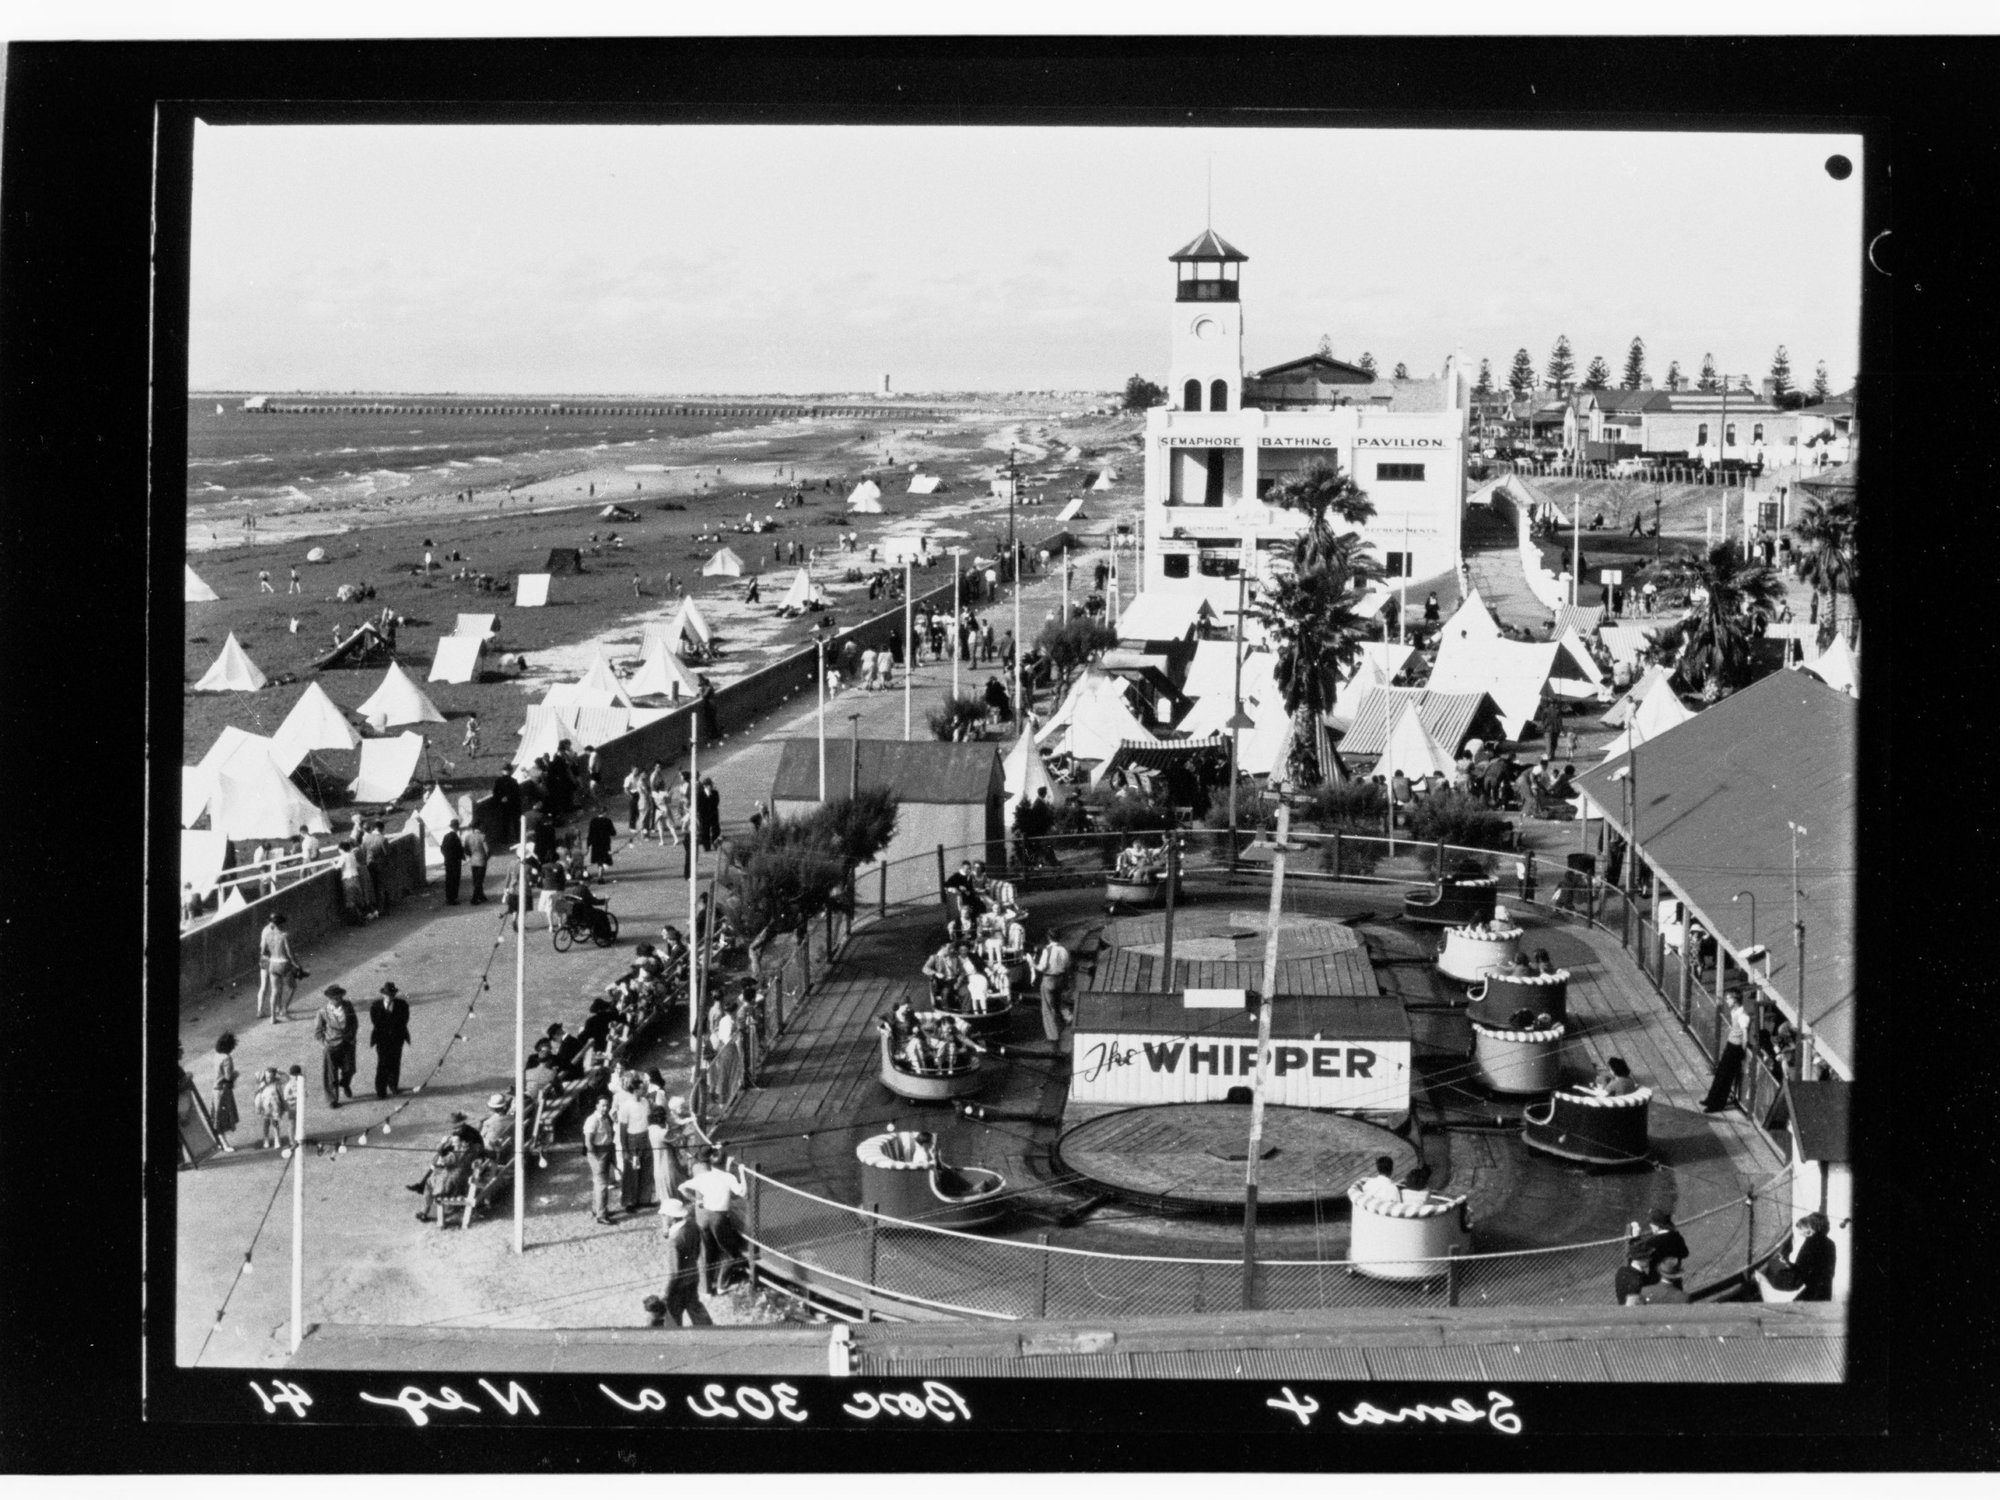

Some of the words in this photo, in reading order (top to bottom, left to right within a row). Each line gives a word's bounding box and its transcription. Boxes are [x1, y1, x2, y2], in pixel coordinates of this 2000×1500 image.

[1160, 437, 1241, 447] SEMAPHORE
[1261, 437, 1332, 447] BATHING
[1082, 1040, 1136, 1083] The
[1142, 1042, 1377, 1079] WHIPPER
